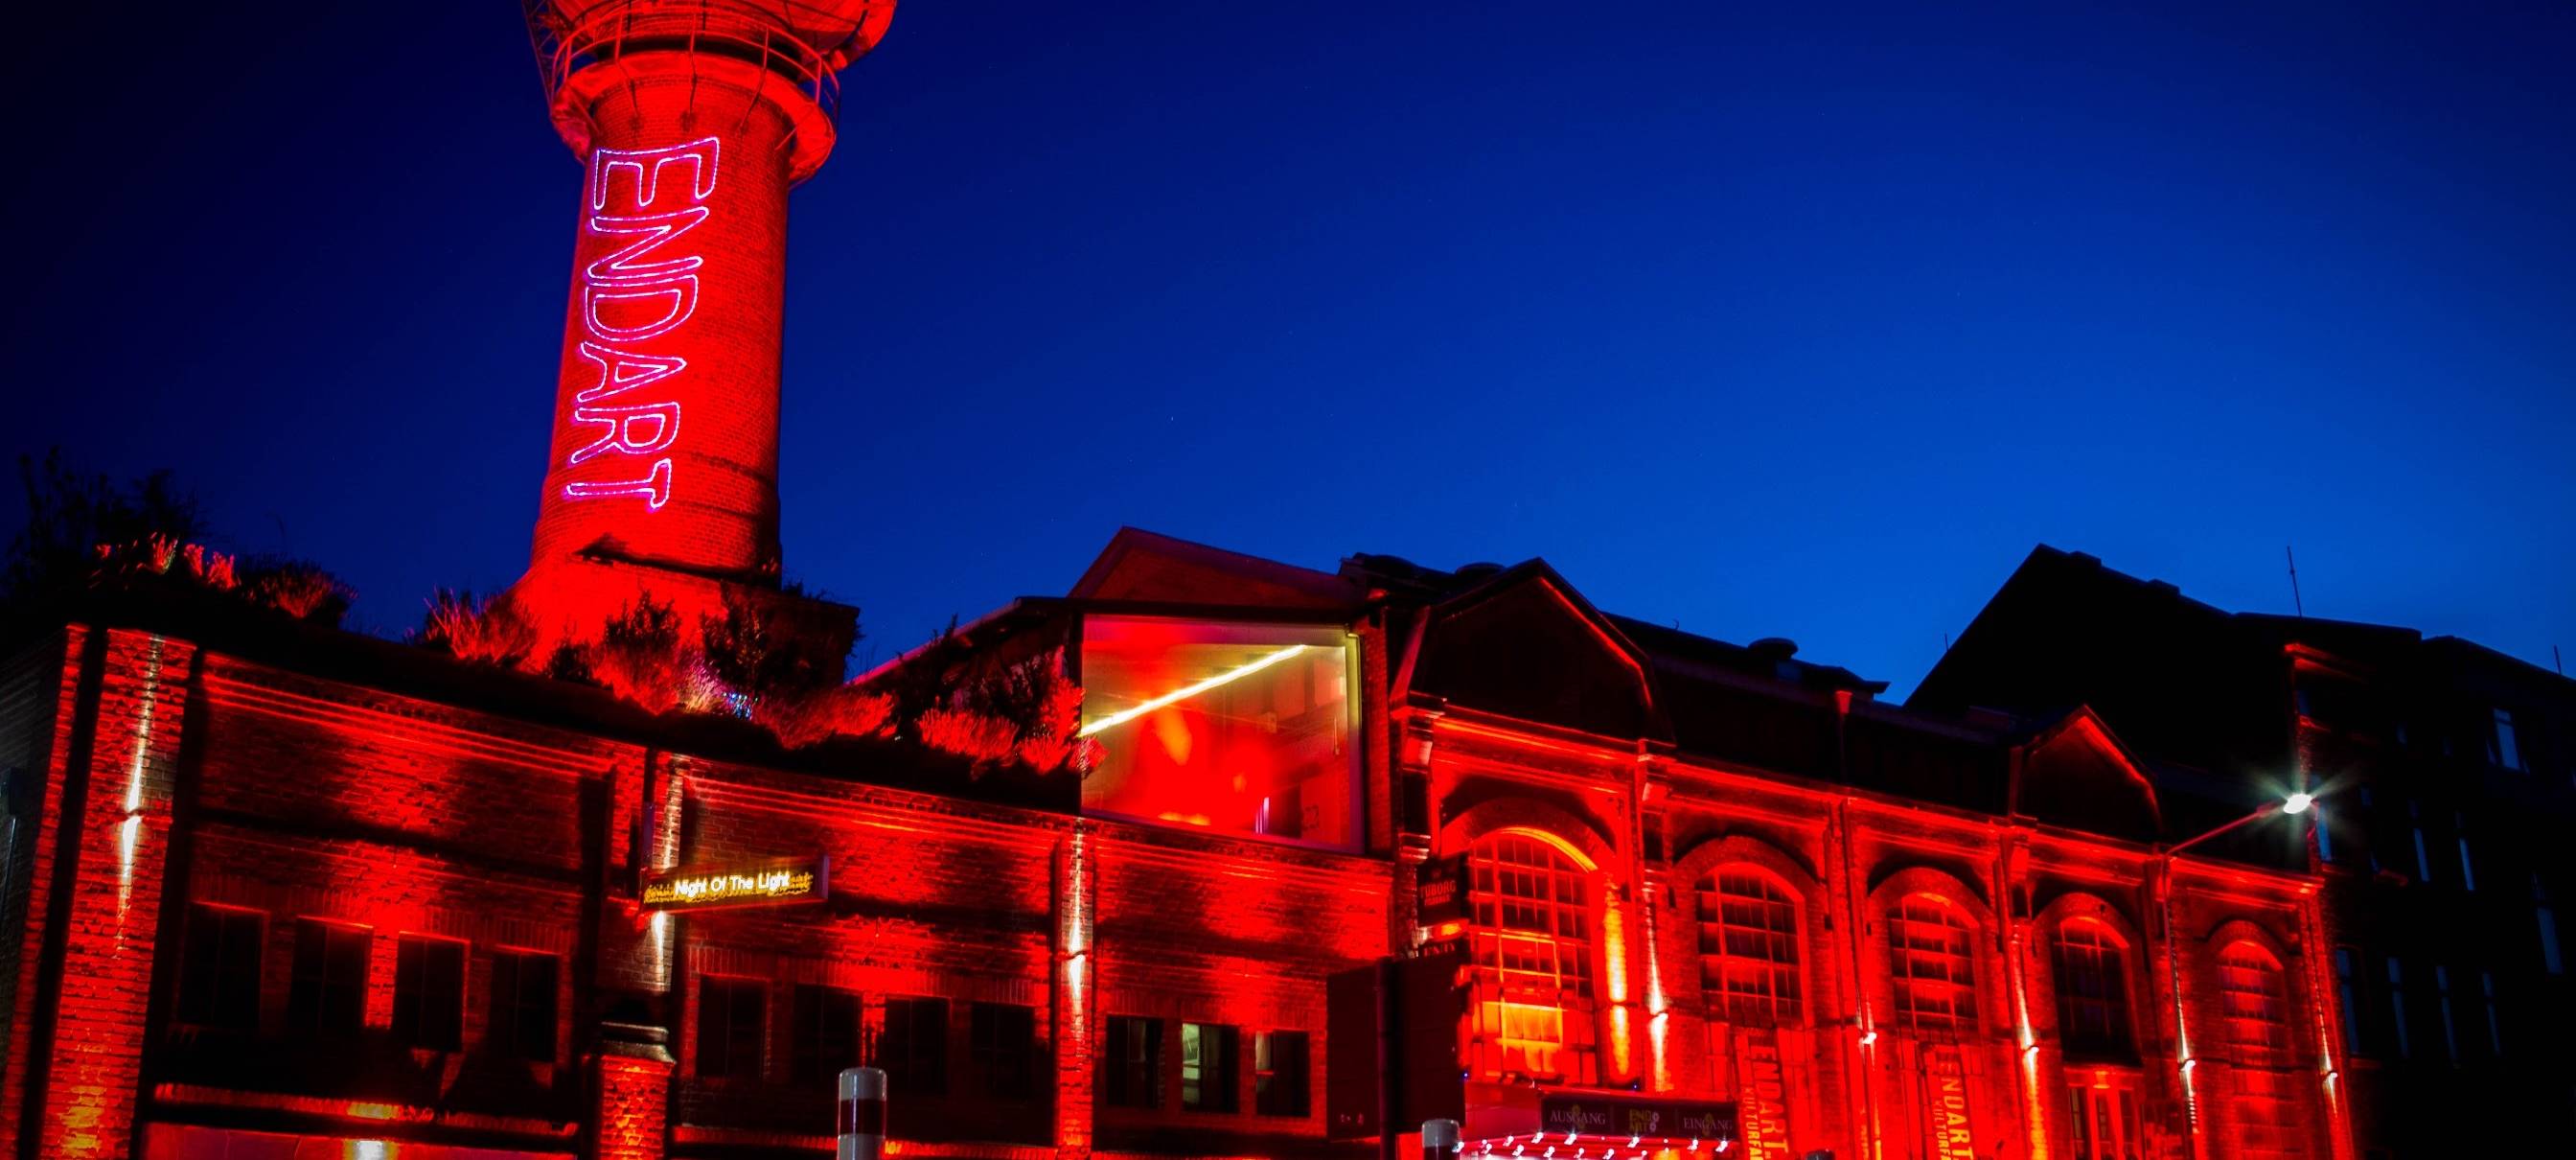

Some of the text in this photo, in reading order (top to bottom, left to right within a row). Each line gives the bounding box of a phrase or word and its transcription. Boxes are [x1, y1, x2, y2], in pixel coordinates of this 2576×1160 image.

[565, 136, 720, 510] ENDART
[674, 870, 791, 898] Night Of The Light
[1419, 879, 1457, 900] TUBORG
[1749, 1045, 1789, 1153] ENDART
[1550, 1109, 1606, 1125] AUSGANG
[1683, 1116, 1734, 1131] EINGANG
